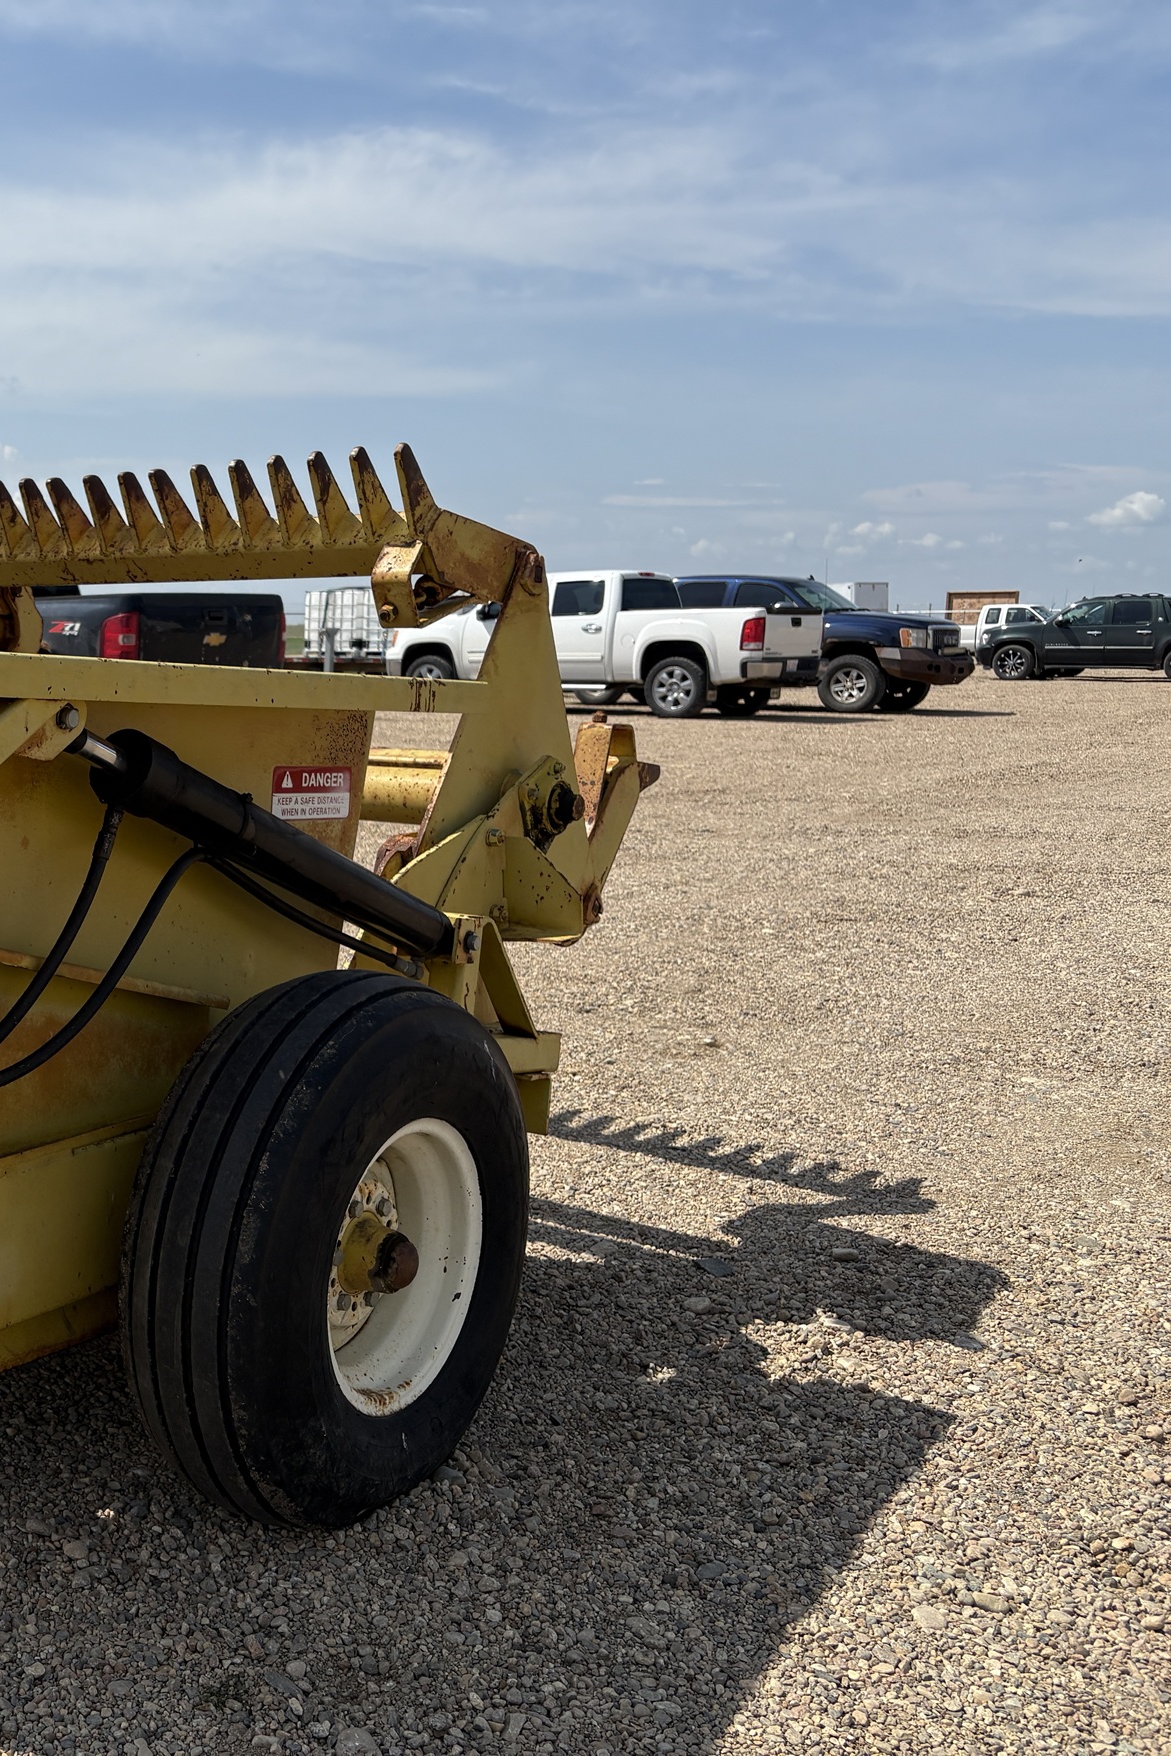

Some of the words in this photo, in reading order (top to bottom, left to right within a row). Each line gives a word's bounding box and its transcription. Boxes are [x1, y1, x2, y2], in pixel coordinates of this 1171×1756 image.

[48, 621, 81, 633] Z71
[302, 773, 344, 787] DANGER
[278, 797, 292, 806] KEEP
[294, 797, 299, 805] A
[300, 797, 315, 805] SAFE
[317, 796, 344, 805] DISTANCE
[281, 808, 299, 816] WHEN
[300, 808, 306, 816] IN
[308, 807, 341, 816] OPERATION
